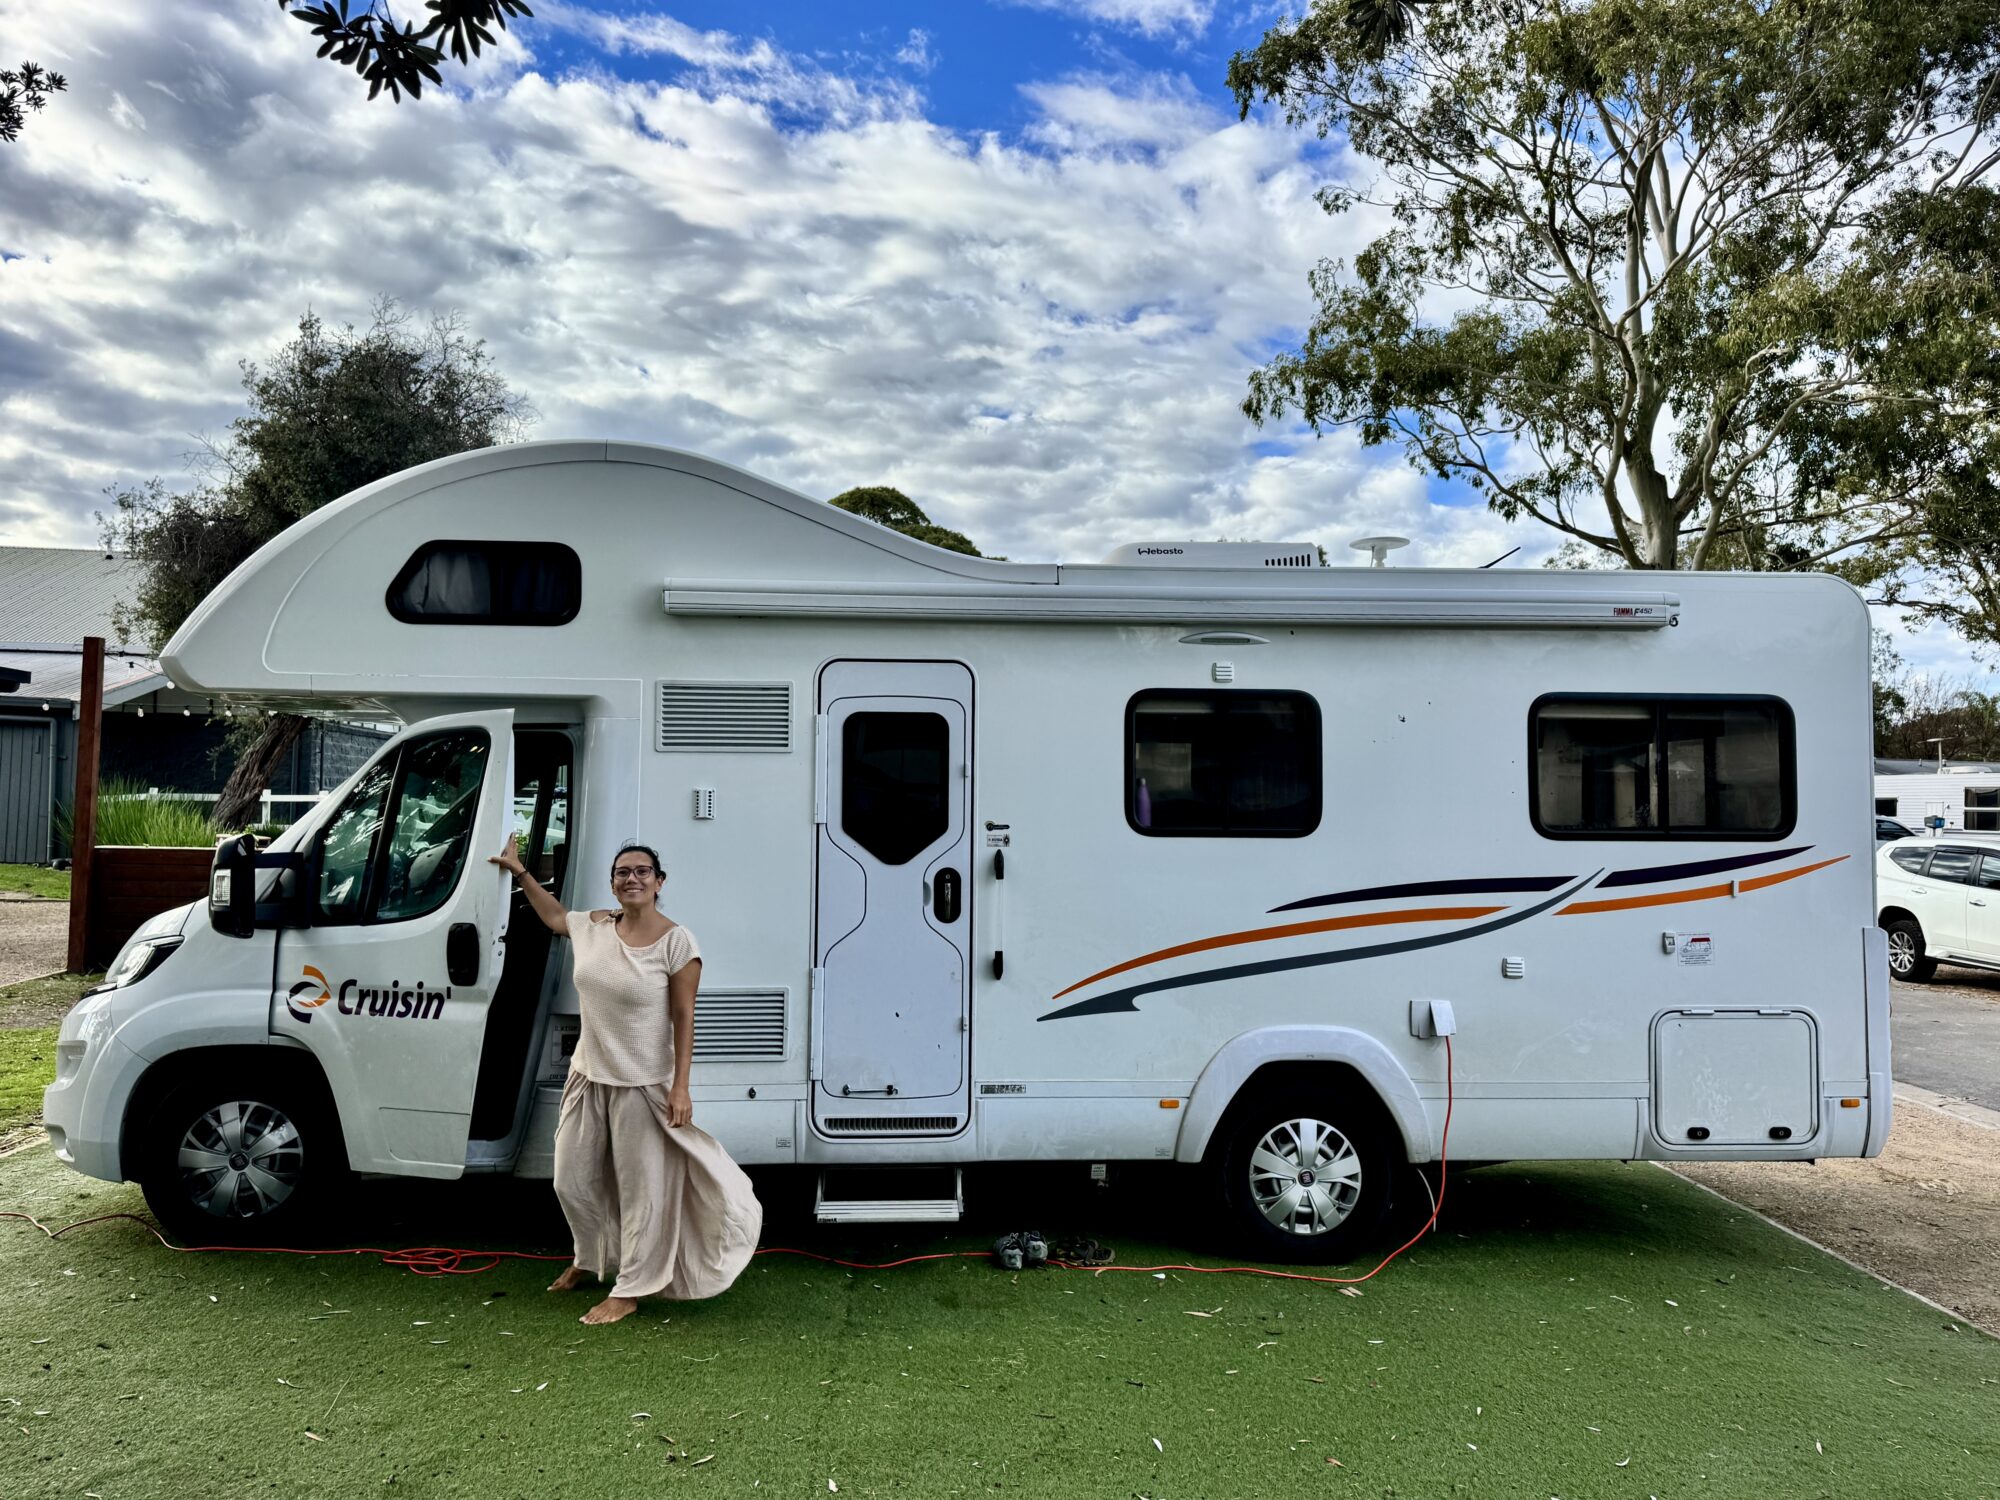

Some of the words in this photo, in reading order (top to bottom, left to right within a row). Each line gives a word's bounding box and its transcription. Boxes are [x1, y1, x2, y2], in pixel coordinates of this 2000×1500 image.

[1137, 547, 1184, 556] Webasto
[1613, 607, 1633, 616] FIAMMA
[337, 978, 452, 1020] Cruisin'
